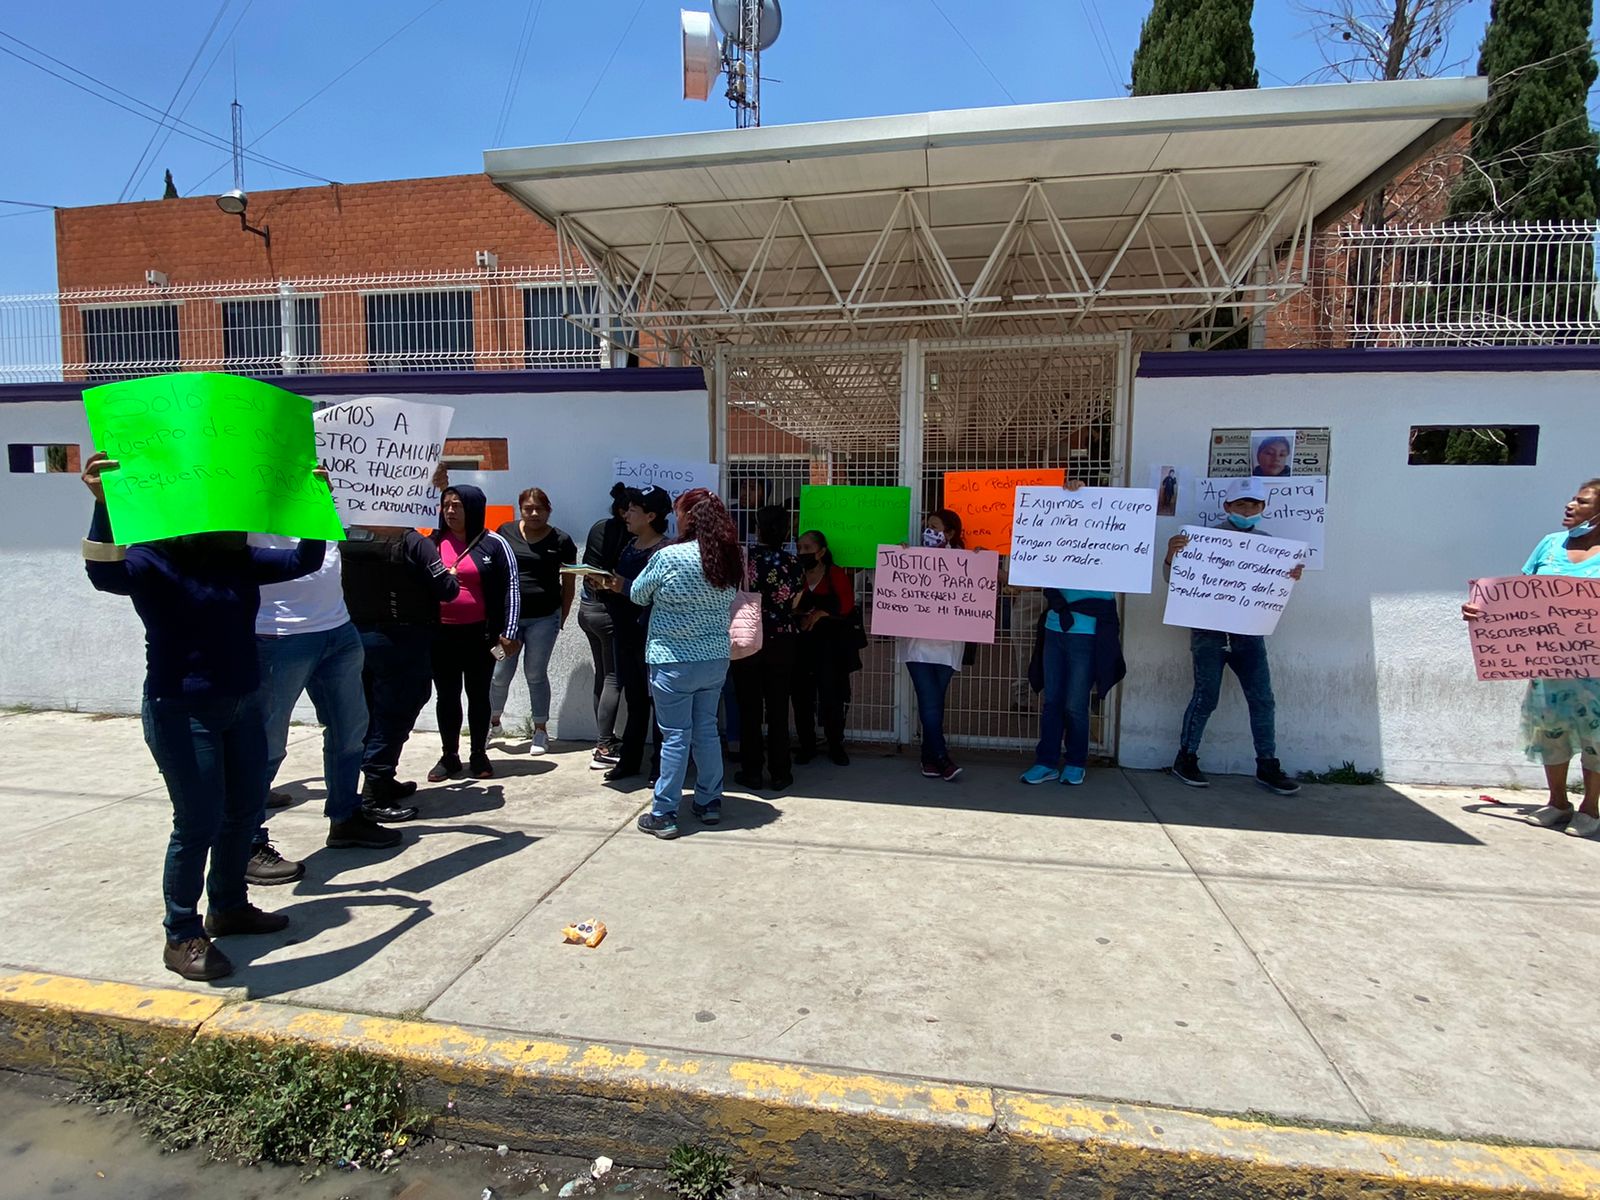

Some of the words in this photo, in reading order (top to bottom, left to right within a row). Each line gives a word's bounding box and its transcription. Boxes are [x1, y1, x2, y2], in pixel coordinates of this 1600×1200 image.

[202, 417, 240, 438] de
[320, 405, 375, 428] IMOS
[394, 412, 409, 435] A
[376, 437, 441, 463] FAMILIAR
[319, 457, 358, 475] NOR
[366, 460, 430, 480] FALLECIDA
[616, 461, 694, 485] Exigimos
[406, 484, 423, 497] EN
[1266, 485, 1315, 506] para
[346, 498, 367, 511] DE
[1020, 492, 1084, 515] Exigimos
[1090, 497, 1103, 510] el
[1110, 500, 1153, 514] cuerpo
[1015, 513, 1029, 526] de
[1032, 514, 1043, 527] la
[1050, 515, 1079, 528] niña
[1198, 511, 1227, 527] que
[1015, 535, 1052, 550] Tengan
[1134, 542, 1150, 555] del
[1239, 539, 1252, 551] el
[1256, 543, 1290, 561] cuerpo
[879, 550, 950, 573] JUSTICIA
[956, 557, 969, 577] Y
[1011, 550, 1038, 562] dolor
[1043, 554, 1057, 563] su
[1207, 551, 1236, 570] tengan
[892, 570, 932, 587] APOYO
[938, 573, 975, 589] PARA
[977, 576, 998, 592] QUE
[1201, 572, 1247, 592] queremos
[1251, 582, 1276, 596] darle
[1278, 588, 1290, 598] su
[876, 587, 898, 599] NOS
[961, 593, 978, 603] EL
[1214, 591, 1236, 603] como
[1239, 594, 1250, 607] lo
[1254, 600, 1285, 613] merece
[914, 604, 931, 614] DE
[937, 606, 949, 616] MI
[953, 606, 996, 620] FAMILIAR
[1474, 622, 1566, 639] RECUPERAR
[1574, 622, 1598, 635] EL
[1476, 644, 1500, 654] DE
[1506, 643, 1527, 653] LA
[1536, 640, 1600, 652] MENOR
[1480, 659, 1496, 668] EN
[1501, 658, 1517, 668] EL
[1525, 654, 1600, 666] ACCIDENTE
